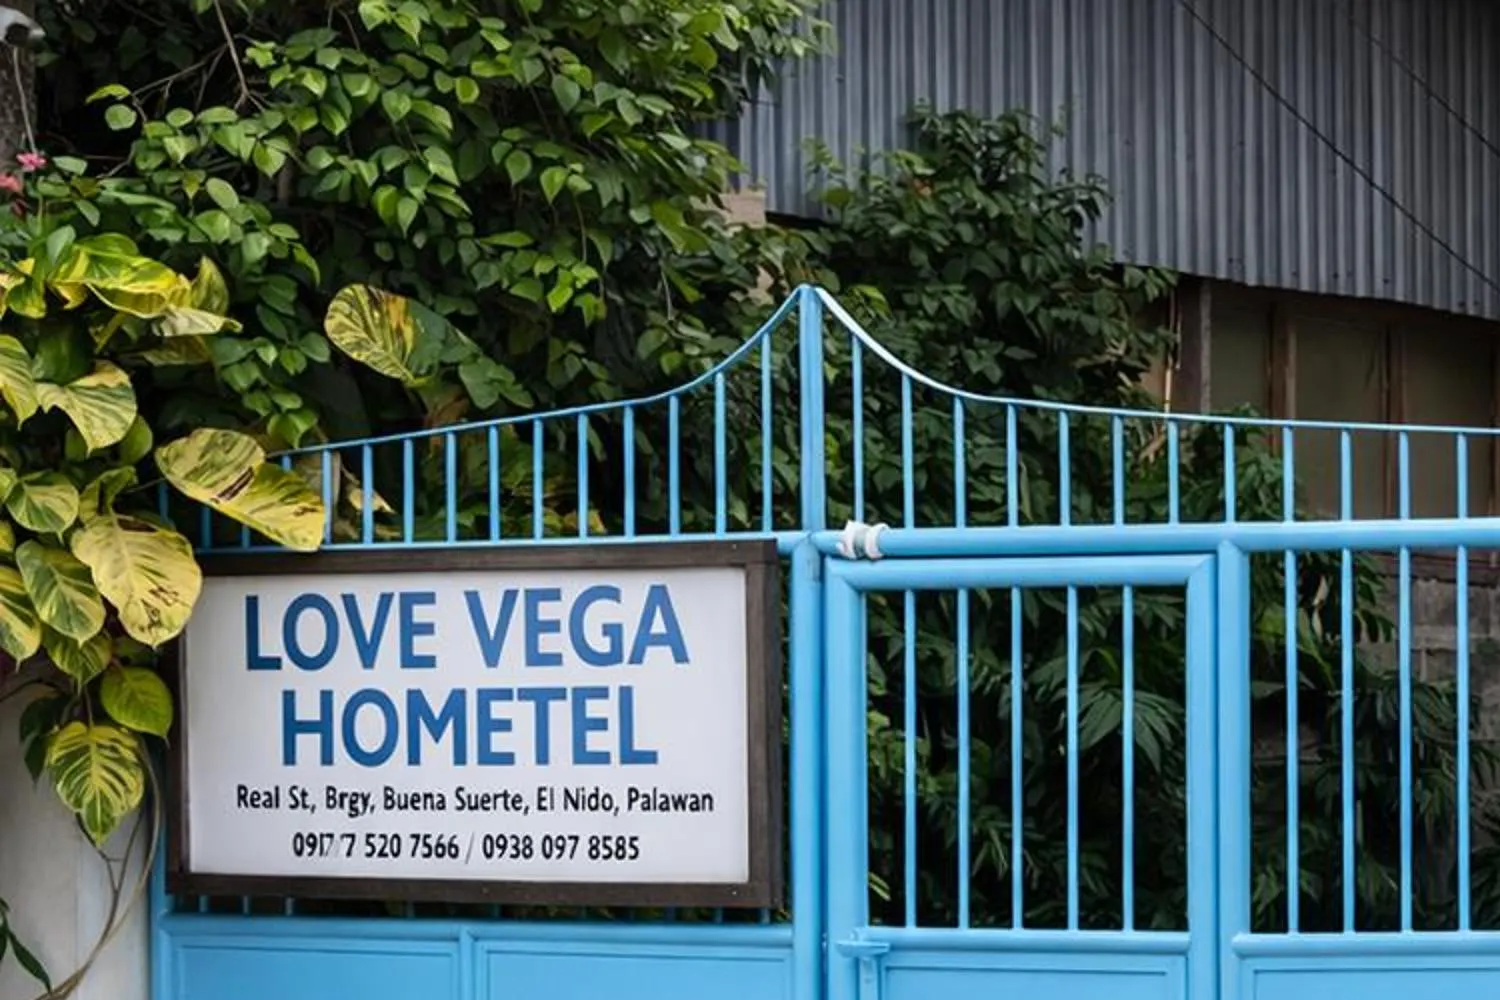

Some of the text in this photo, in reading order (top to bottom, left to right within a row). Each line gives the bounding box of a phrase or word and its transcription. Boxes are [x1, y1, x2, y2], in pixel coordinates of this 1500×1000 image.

[245, 584, 689, 672] LOVE VEGA
[283, 686, 658, 767] HOMETEL
[236, 784, 714, 819] Real St, Brgy, Buena Suerte, El Nido, Palawan
[364, 833, 402, 859] 520
[410, 833, 460, 860] 7566
[483, 833, 534, 860] 0938
[542, 834, 579, 860] 097
[587, 835, 640, 861] 8585
